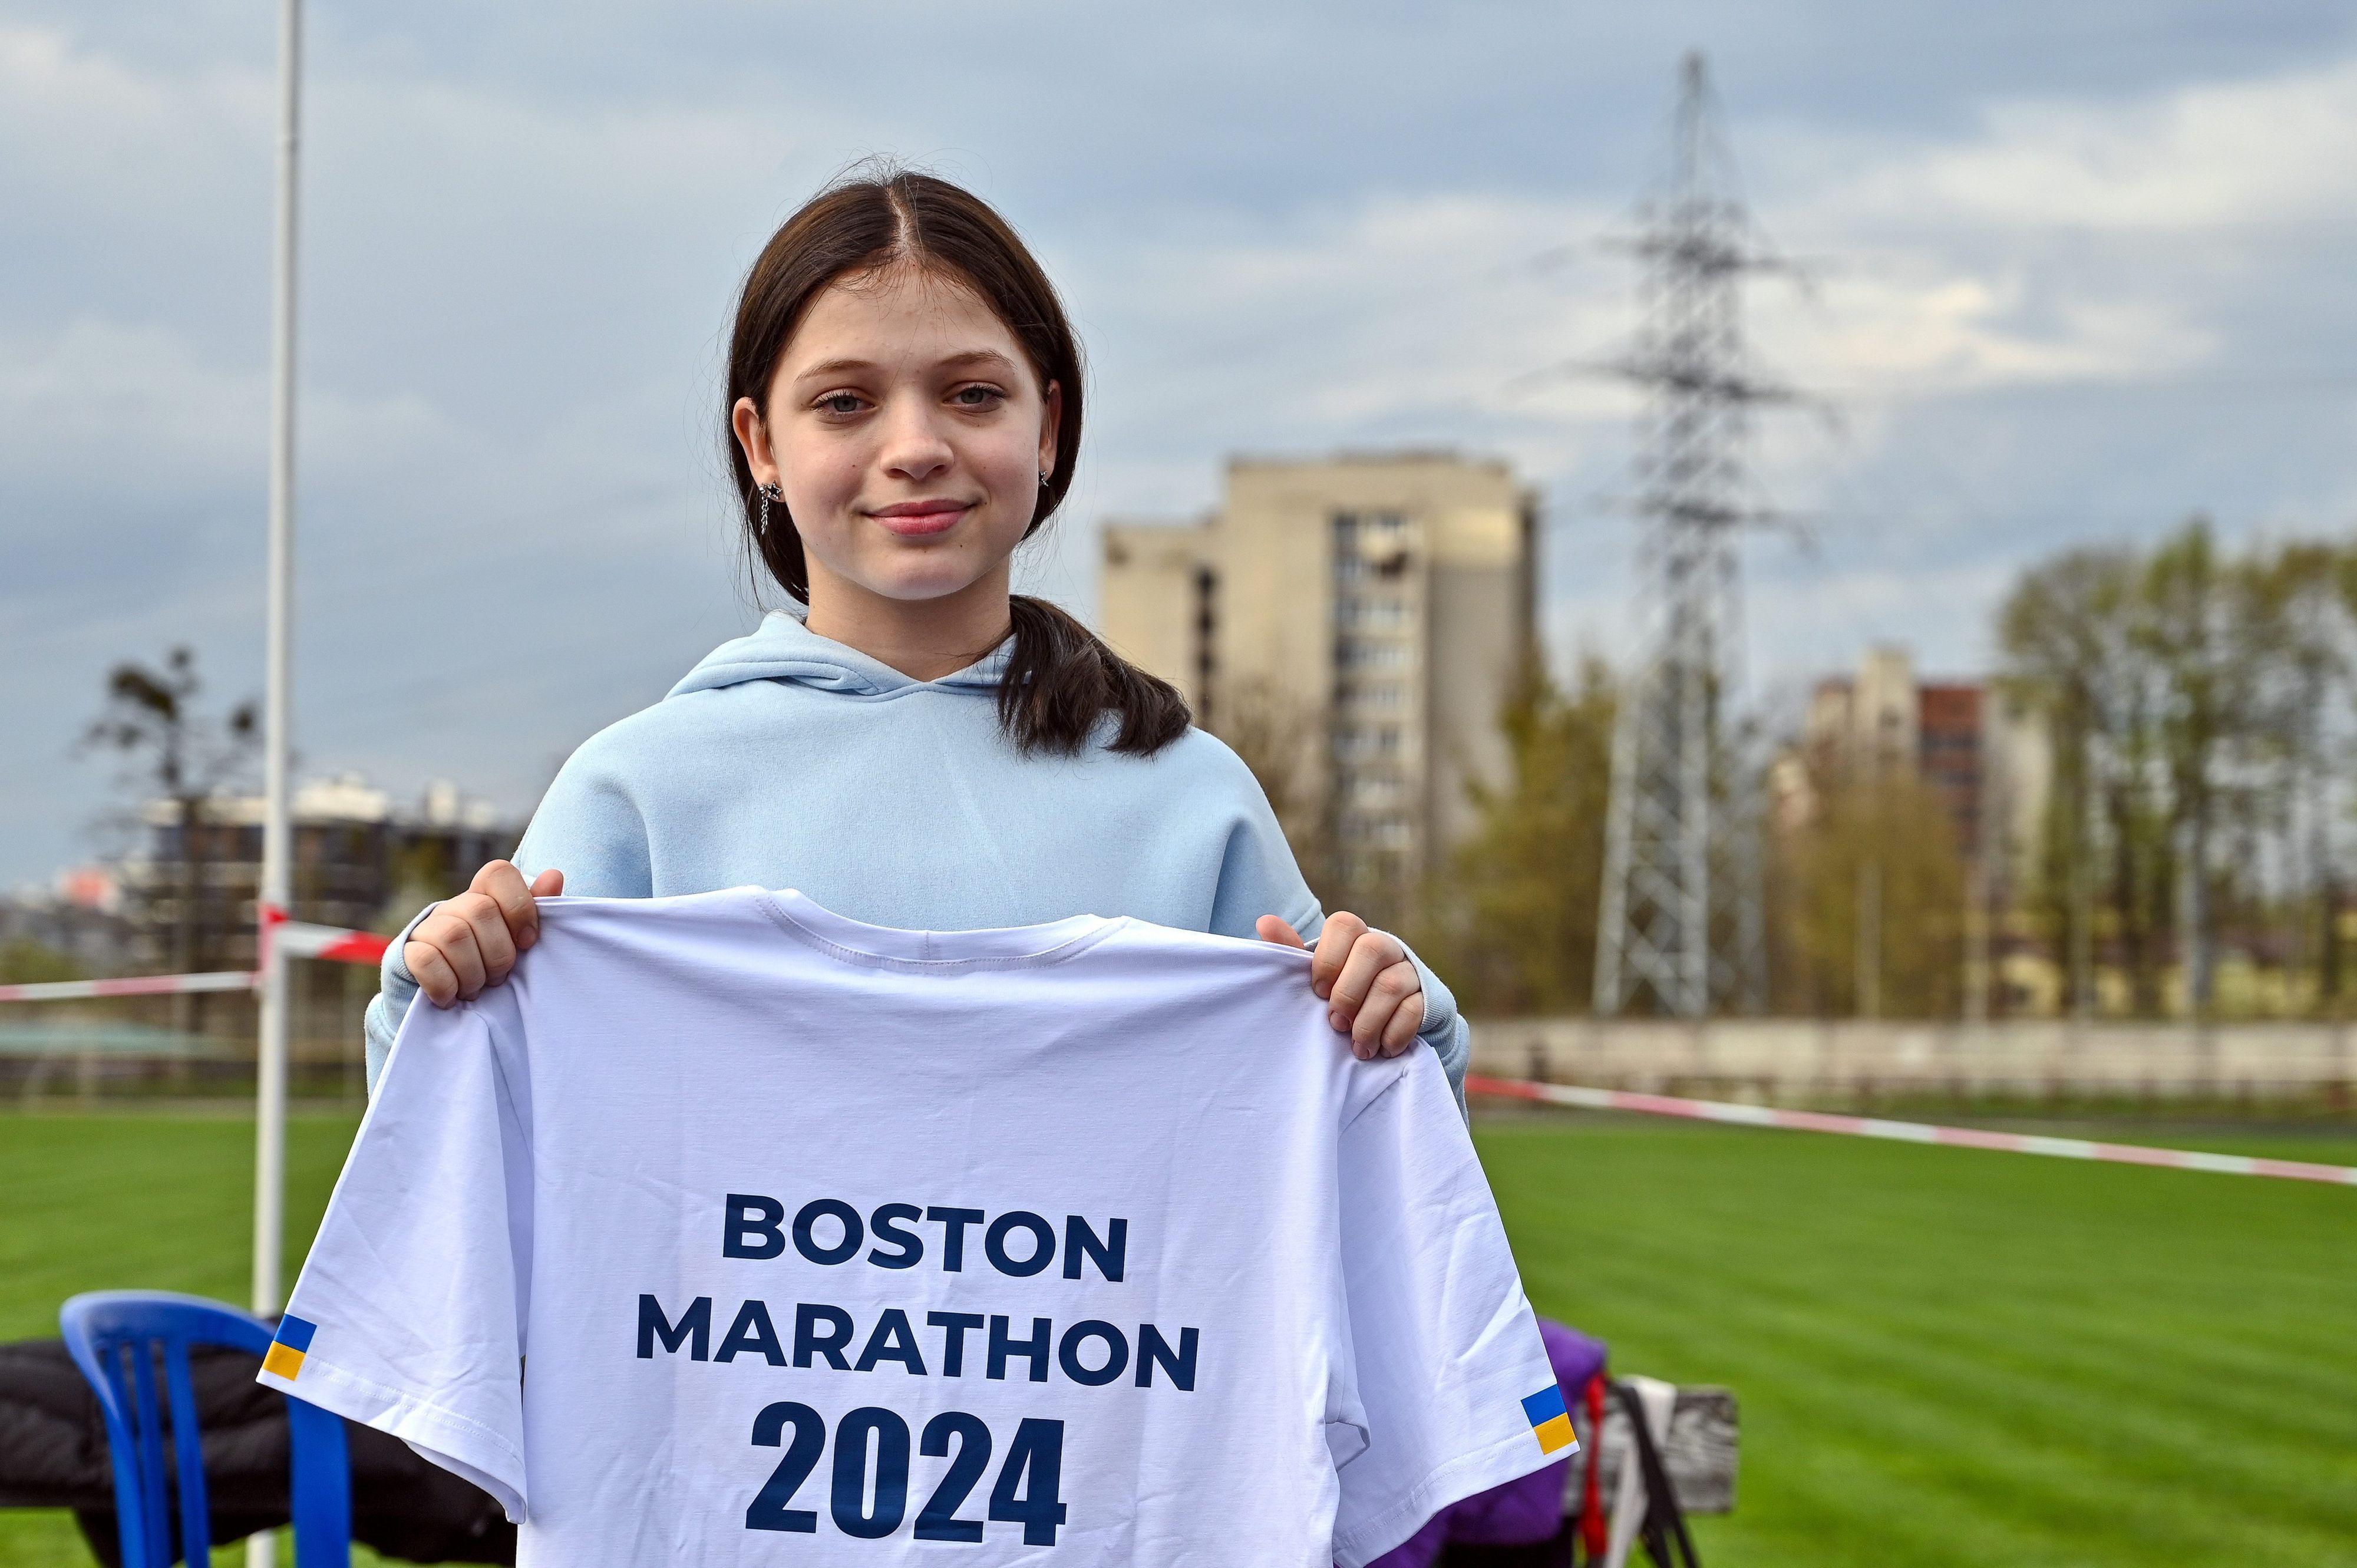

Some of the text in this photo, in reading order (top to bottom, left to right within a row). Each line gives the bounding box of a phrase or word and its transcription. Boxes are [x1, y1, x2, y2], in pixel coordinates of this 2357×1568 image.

[722, 1193, 1128, 1283] BOSTON
[636, 1293, 1200, 1392] MARATHON
[745, 1401, 1067, 1547] 2024
